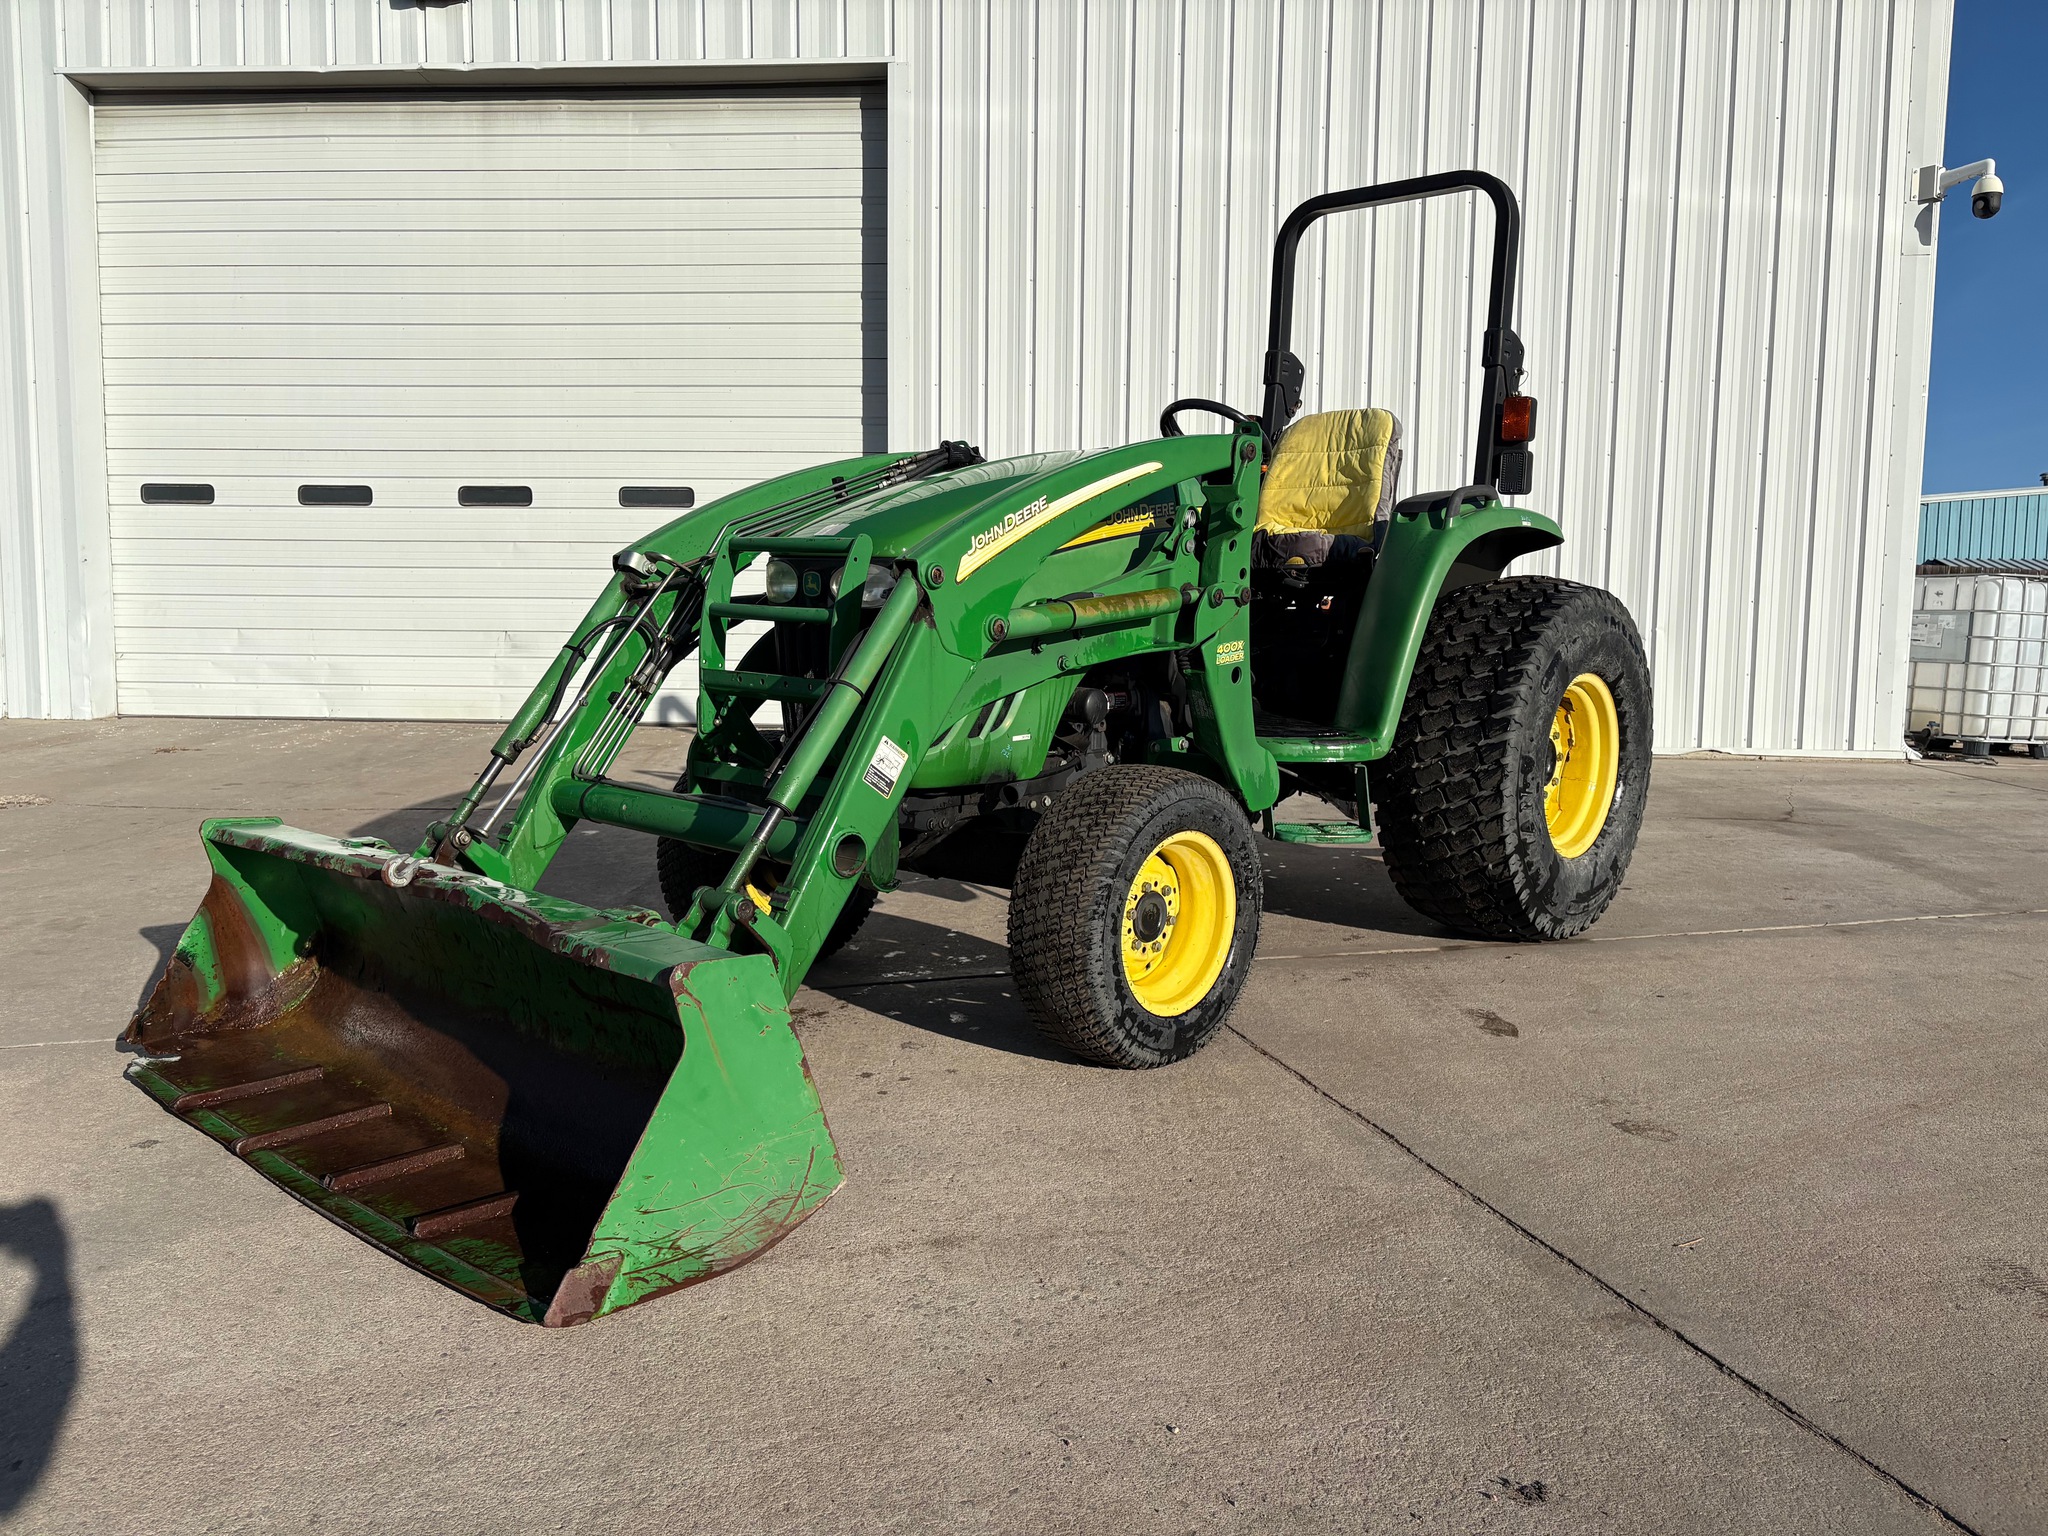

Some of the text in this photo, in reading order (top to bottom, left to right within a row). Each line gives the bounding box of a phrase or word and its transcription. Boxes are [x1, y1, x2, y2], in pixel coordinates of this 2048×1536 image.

[1107, 503, 1176, 525] JOHN DEERE
[967, 494, 1048, 555] JOHN DEERE
[1216, 640, 1245, 654] 400X
[1216, 652, 1245, 665] LOADER
